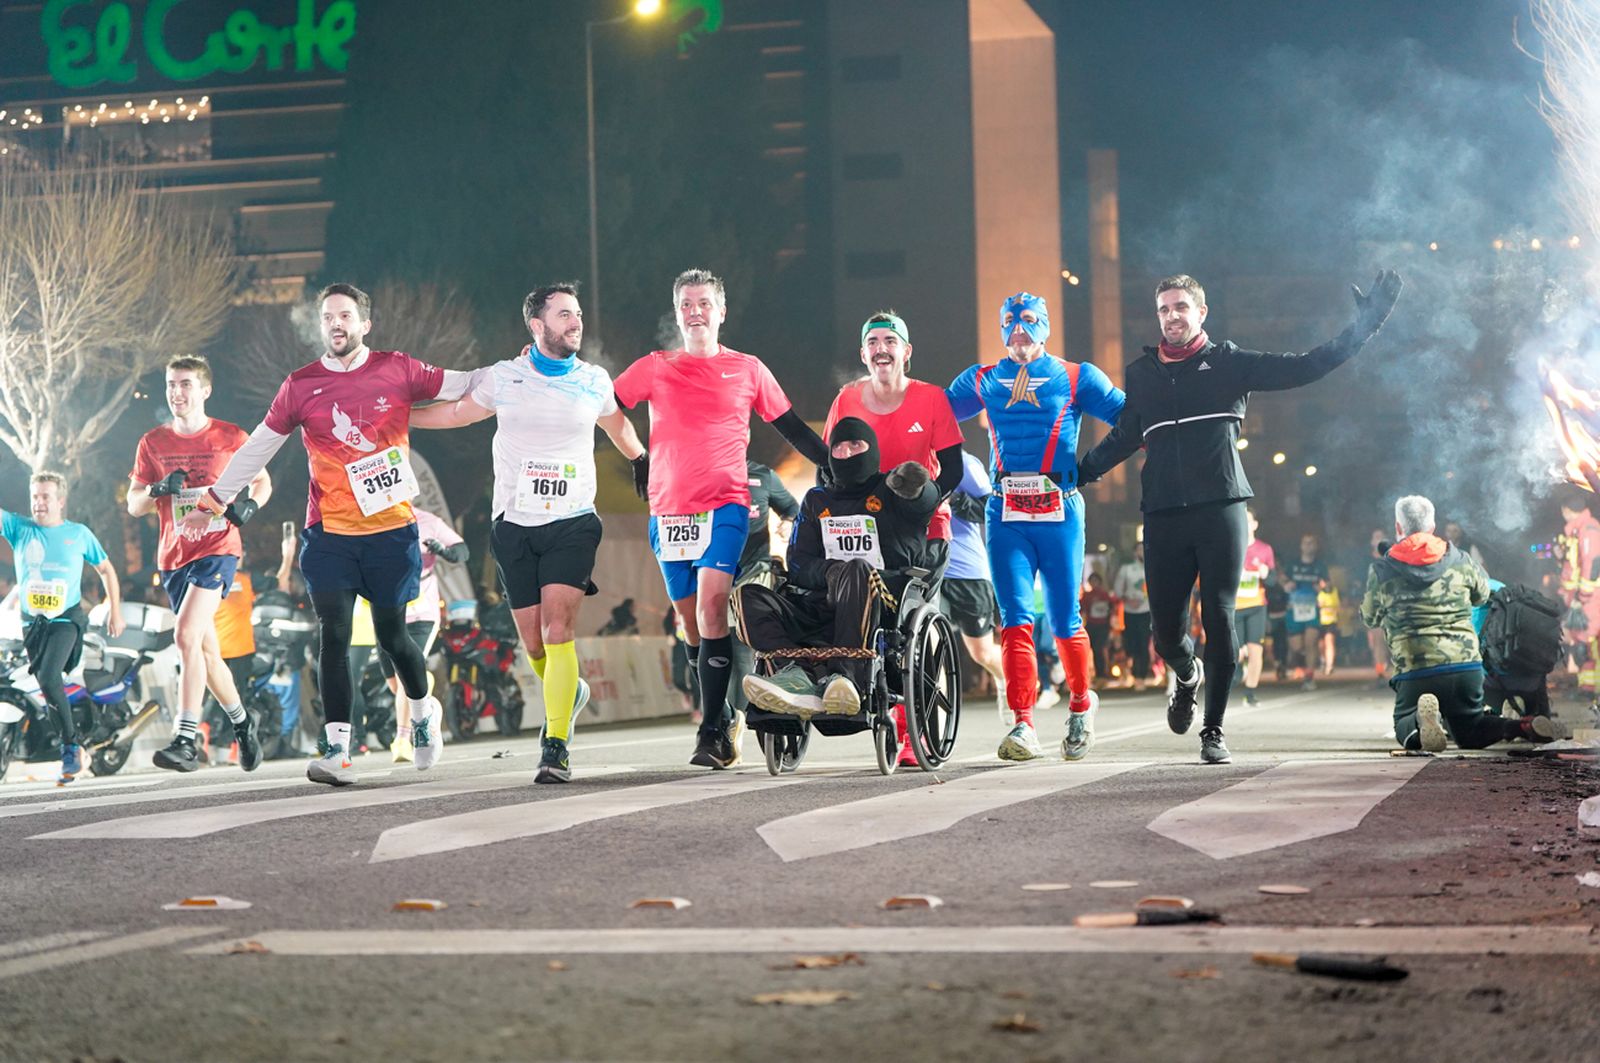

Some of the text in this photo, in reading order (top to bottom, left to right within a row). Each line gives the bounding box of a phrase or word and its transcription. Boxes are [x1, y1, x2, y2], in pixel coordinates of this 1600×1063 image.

[41, 0, 357, 88] El Corte
[346, 431, 361, 446] 43
[363, 467, 402, 494] 3152
[532, 478, 568, 496] 1610
[666, 524, 700, 542] 7259
[836, 534, 872, 551] 1076
[32, 594, 59, 607] 5845
